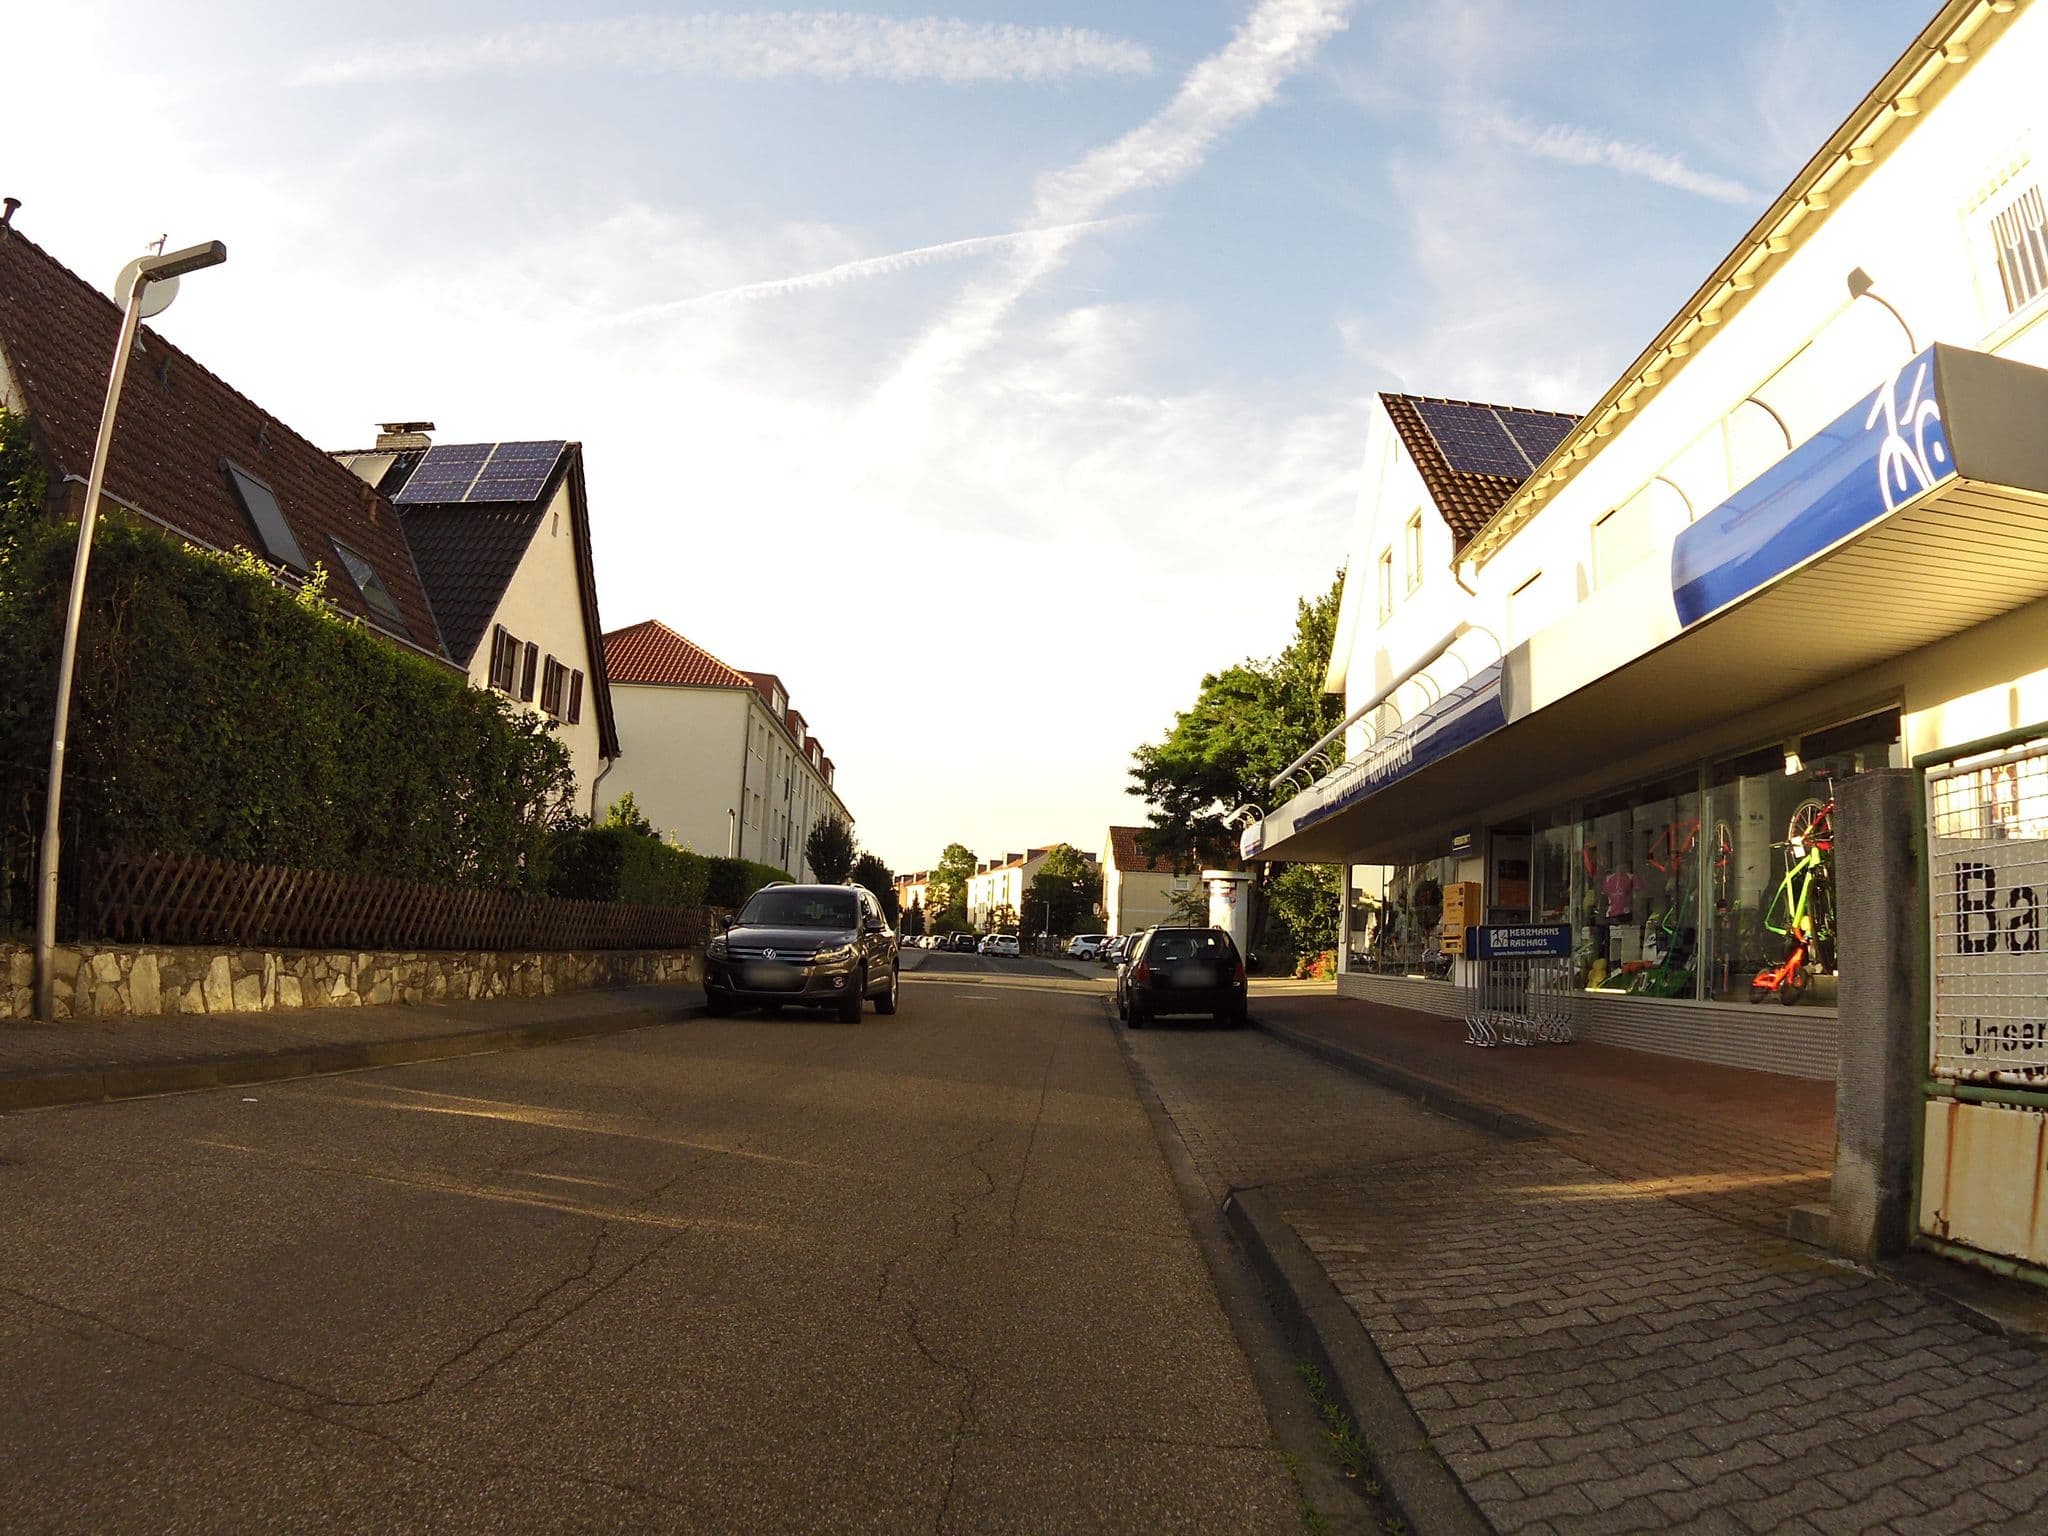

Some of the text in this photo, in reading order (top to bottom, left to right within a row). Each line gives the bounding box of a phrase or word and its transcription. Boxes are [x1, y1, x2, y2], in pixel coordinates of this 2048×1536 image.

[1955, 862, 2048, 956] Ba
[1509, 927, 1560, 937] HERRMANNS
[1509, 938, 1548, 948] RADHAUS
